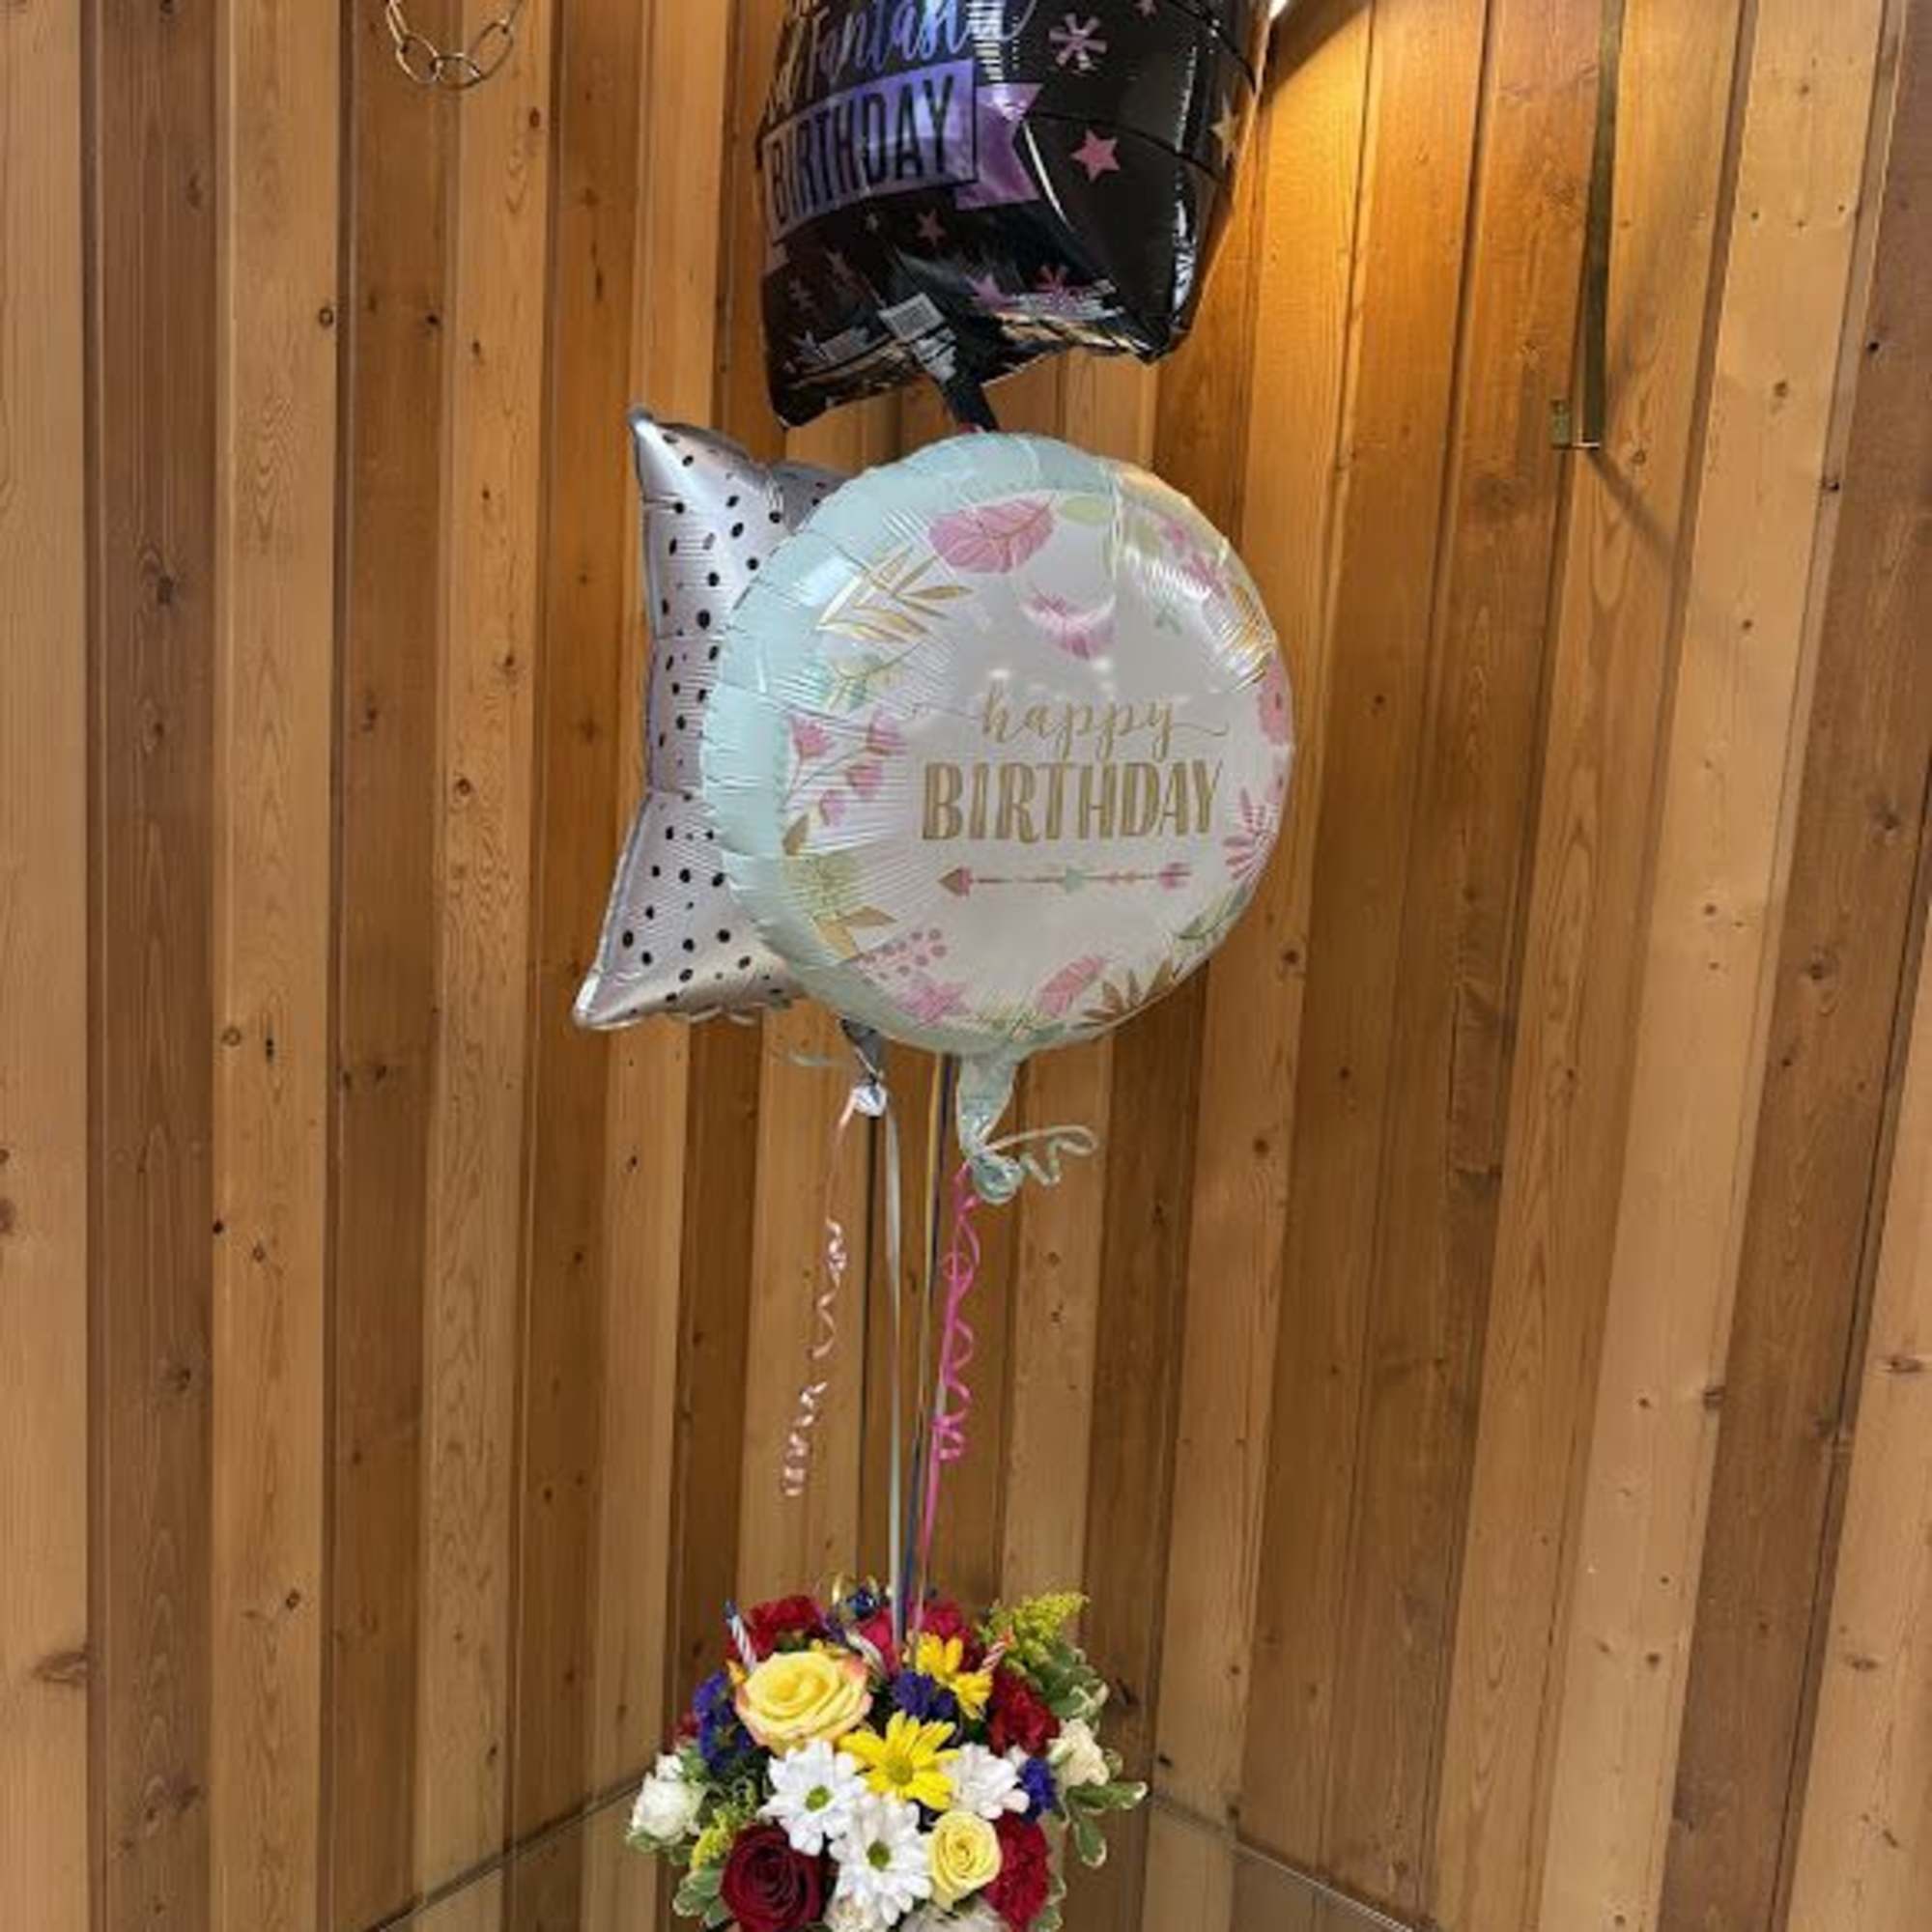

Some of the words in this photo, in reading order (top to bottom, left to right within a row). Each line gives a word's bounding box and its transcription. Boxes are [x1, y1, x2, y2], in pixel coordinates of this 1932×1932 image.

[771, 74, 955, 227] BIRTHDAY
[978, 680, 1229, 763] happy
[922, 758, 1223, 843] BIRTHDAY
